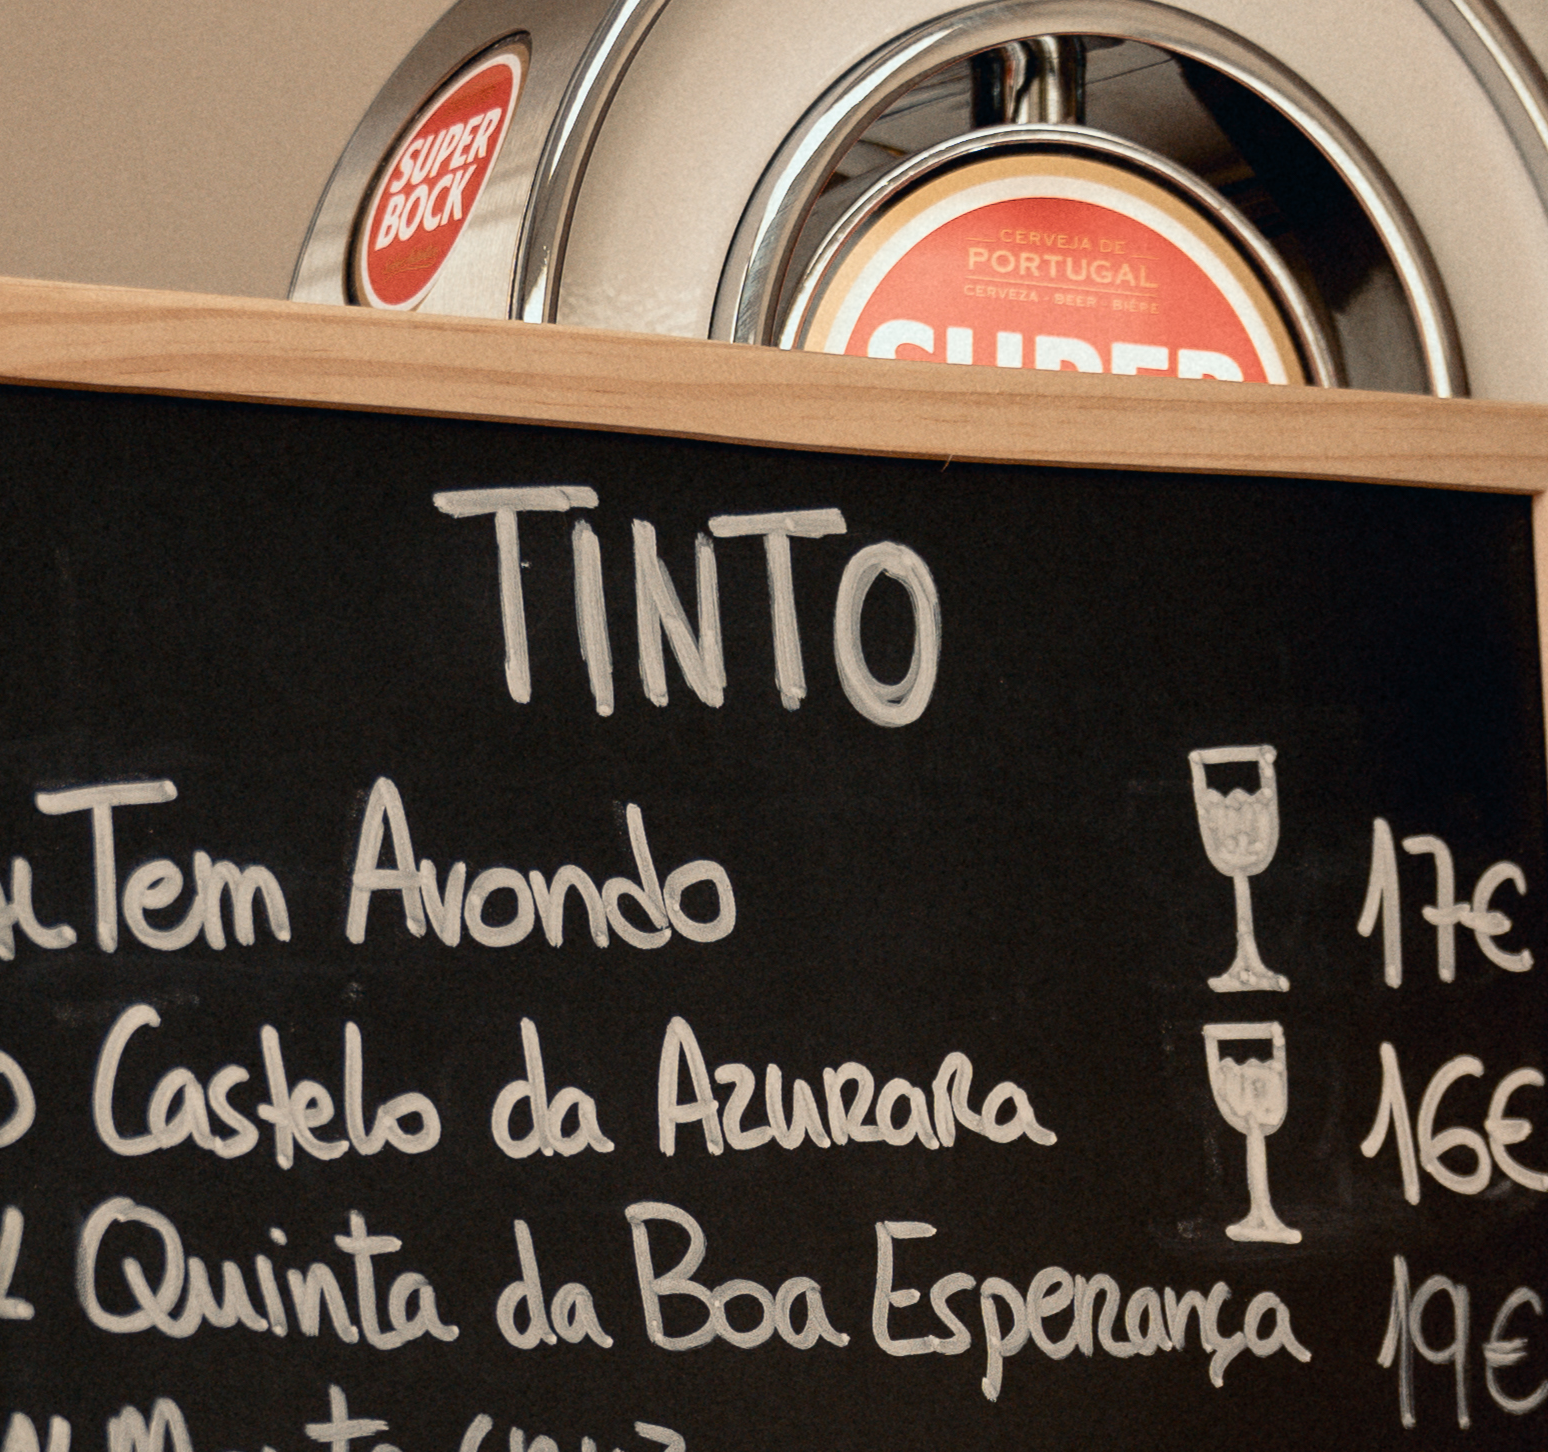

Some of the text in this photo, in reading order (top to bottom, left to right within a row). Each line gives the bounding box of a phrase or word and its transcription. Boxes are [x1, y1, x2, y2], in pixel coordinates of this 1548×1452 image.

[389, 108, 502, 194] SUPER
[374, 163, 477, 251] BOCK
[1001, 229, 1127, 255] CERVEJA DE
[964, 285, 1039, 302] CERVEZA
[1054, 293, 1097, 307] BEER
[968, 247, 1159, 288] PORTUGAL
[433, 485, 942, 728] TINTO
[35, 779, 291, 953] Tem
[1357, 818, 1534, 989] 17€
[92, 1003, 441, 1170] Castelo
[491, 1017, 615, 1159] da
[76, 1196, 459, 1350] Quinta
[496, 1219, 614, 1349] da
[624, 1201, 850, 1351] Boa
[872, 1220, 1312, 1402] Esperança
